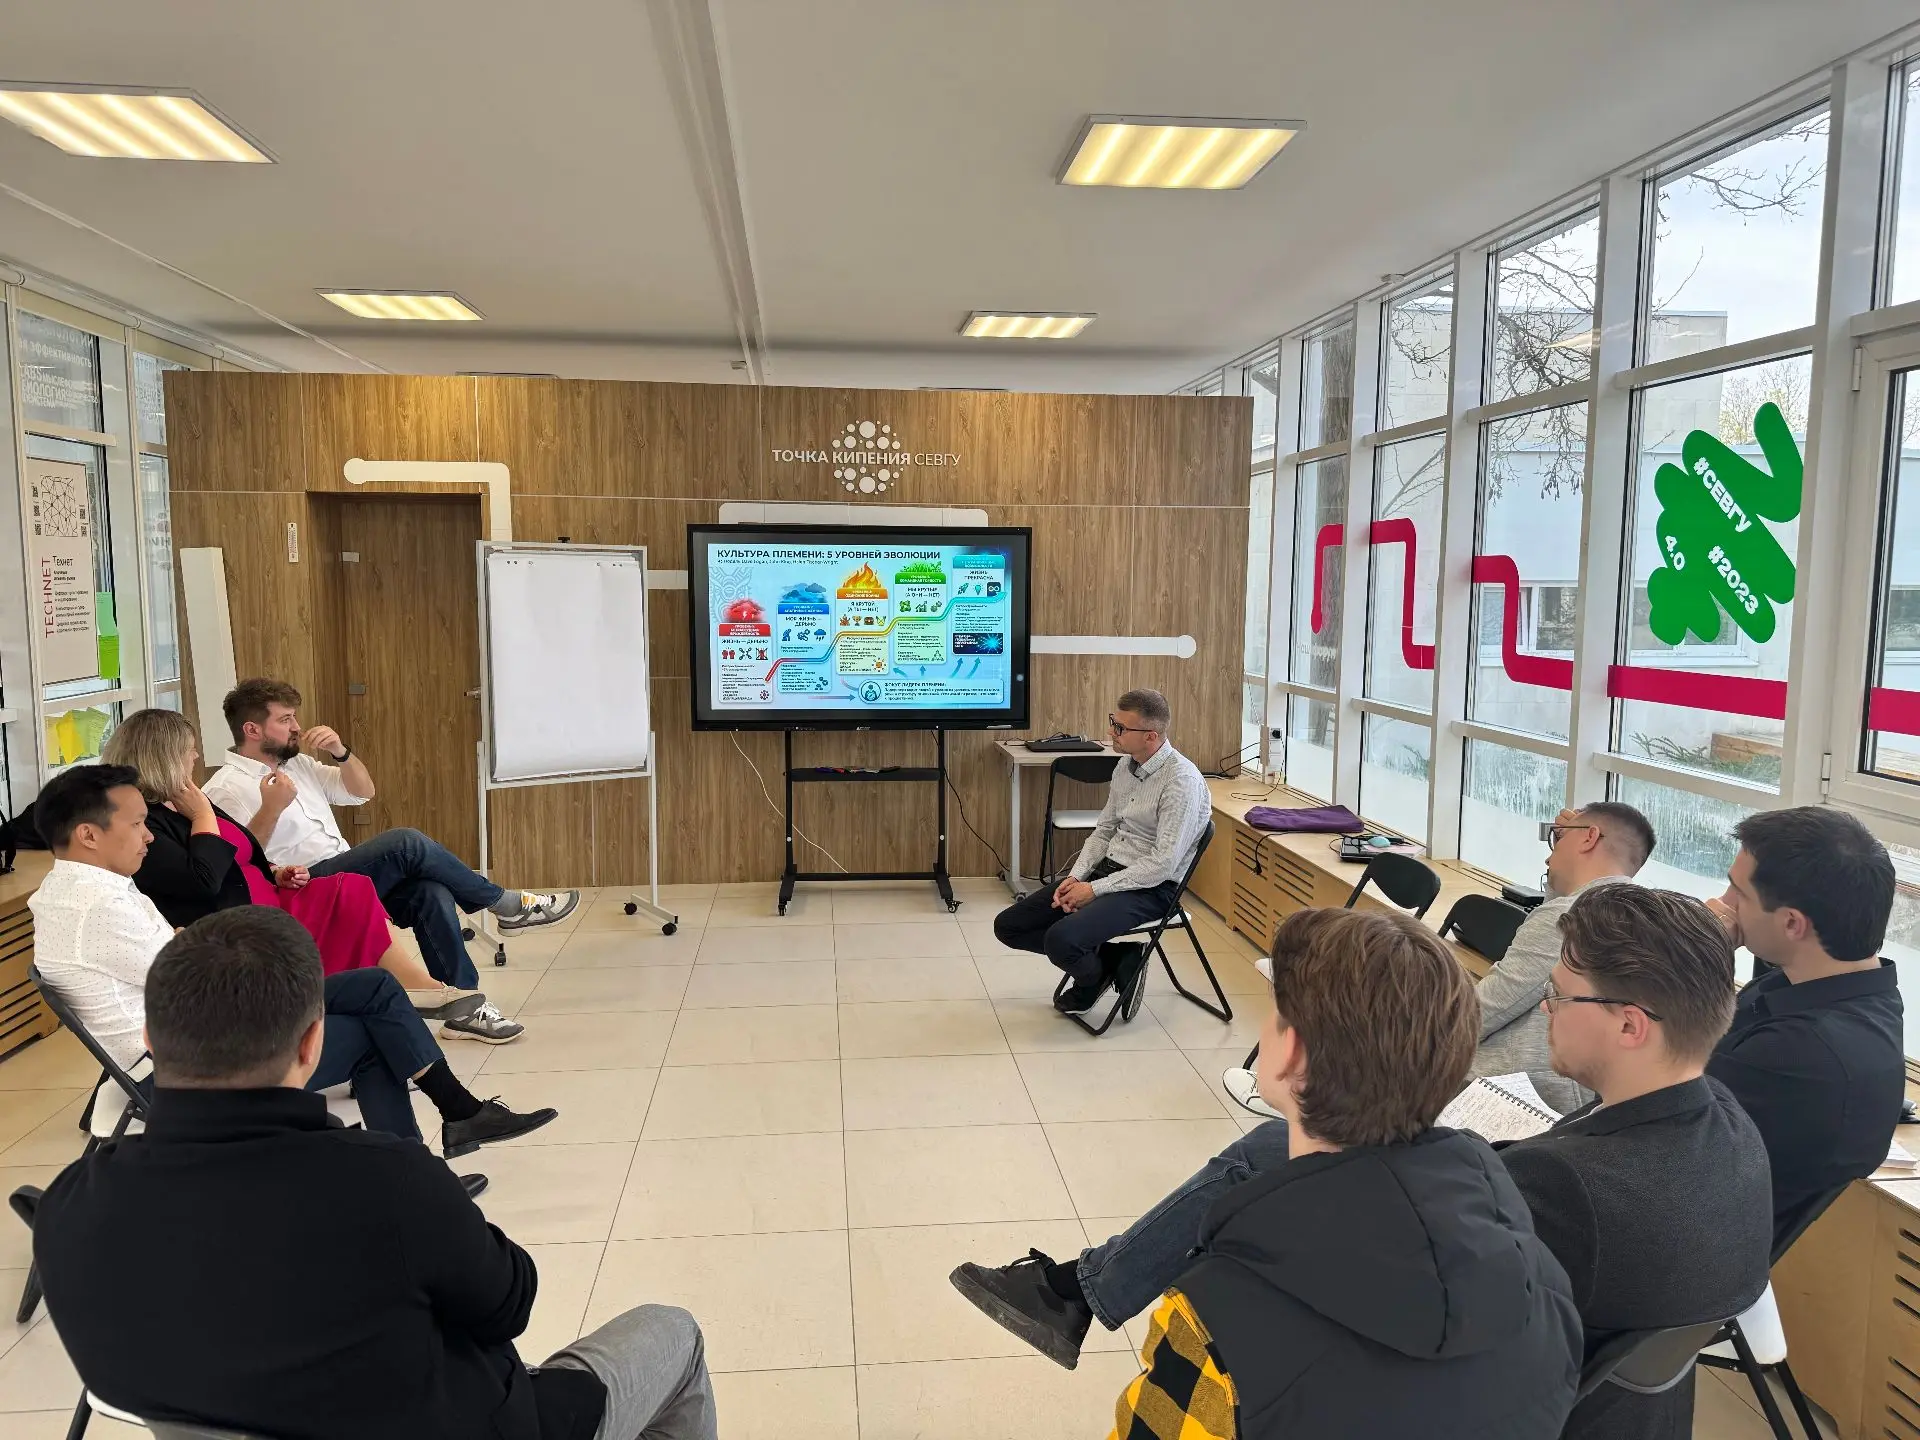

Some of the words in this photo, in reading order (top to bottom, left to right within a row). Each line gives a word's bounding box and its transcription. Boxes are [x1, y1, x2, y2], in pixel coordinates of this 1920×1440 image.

[772, 450, 829, 463] ТОЧКА
[832, 451, 910, 465] КИПЕНИЯ
[914, 454, 961, 466] СЕВГУ
[1693, 456, 1752, 533] #СЕВГУ
[773, 550, 824, 558] ПЛЕМЕНИ:
[835, 550, 882, 559] УРОВНЕЙ
[884, 552, 940, 560] ЭВОЛЮЦИИ
[1665, 535, 1685, 570] 4.0
[41, 556, 54, 638] TECHNET
[1708, 546, 1758, 614] #2023
